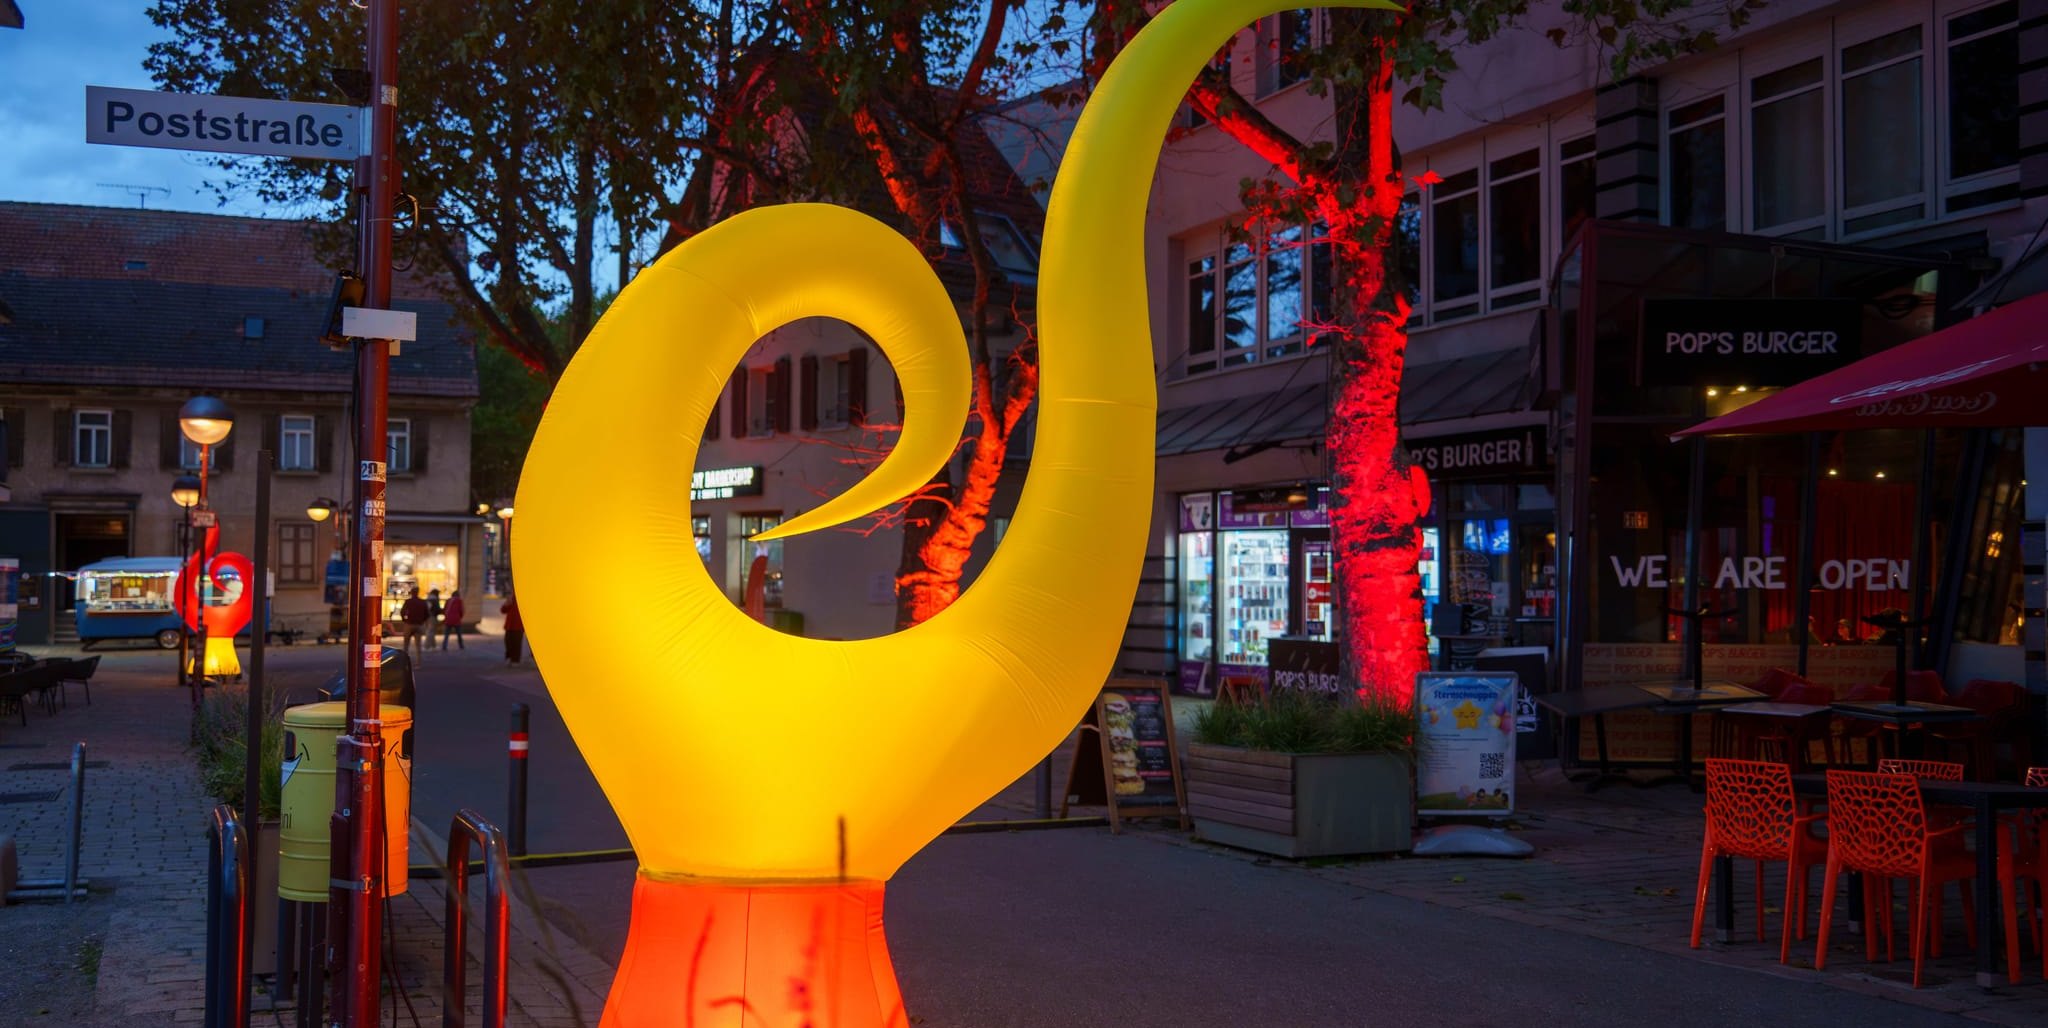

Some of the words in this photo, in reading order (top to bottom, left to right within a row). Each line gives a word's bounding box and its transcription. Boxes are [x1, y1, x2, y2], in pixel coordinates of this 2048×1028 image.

[106, 100, 344, 148] Poststraße
[1665, 331, 1734, 354] POP'S
[1742, 331, 1838, 354] BURGER
[1411, 446, 1440, 471] P'S
[1441, 439, 1522, 470] BURGER
[1610, 555, 1668, 588] WE
[1714, 556, 1787, 590] ARE
[1819, 557, 1911, 592] OPEN
[1703, 648, 1725, 658] OP'S
[1274, 669, 1305, 690] POP'S
[1308, 671, 1339, 694] BURG
